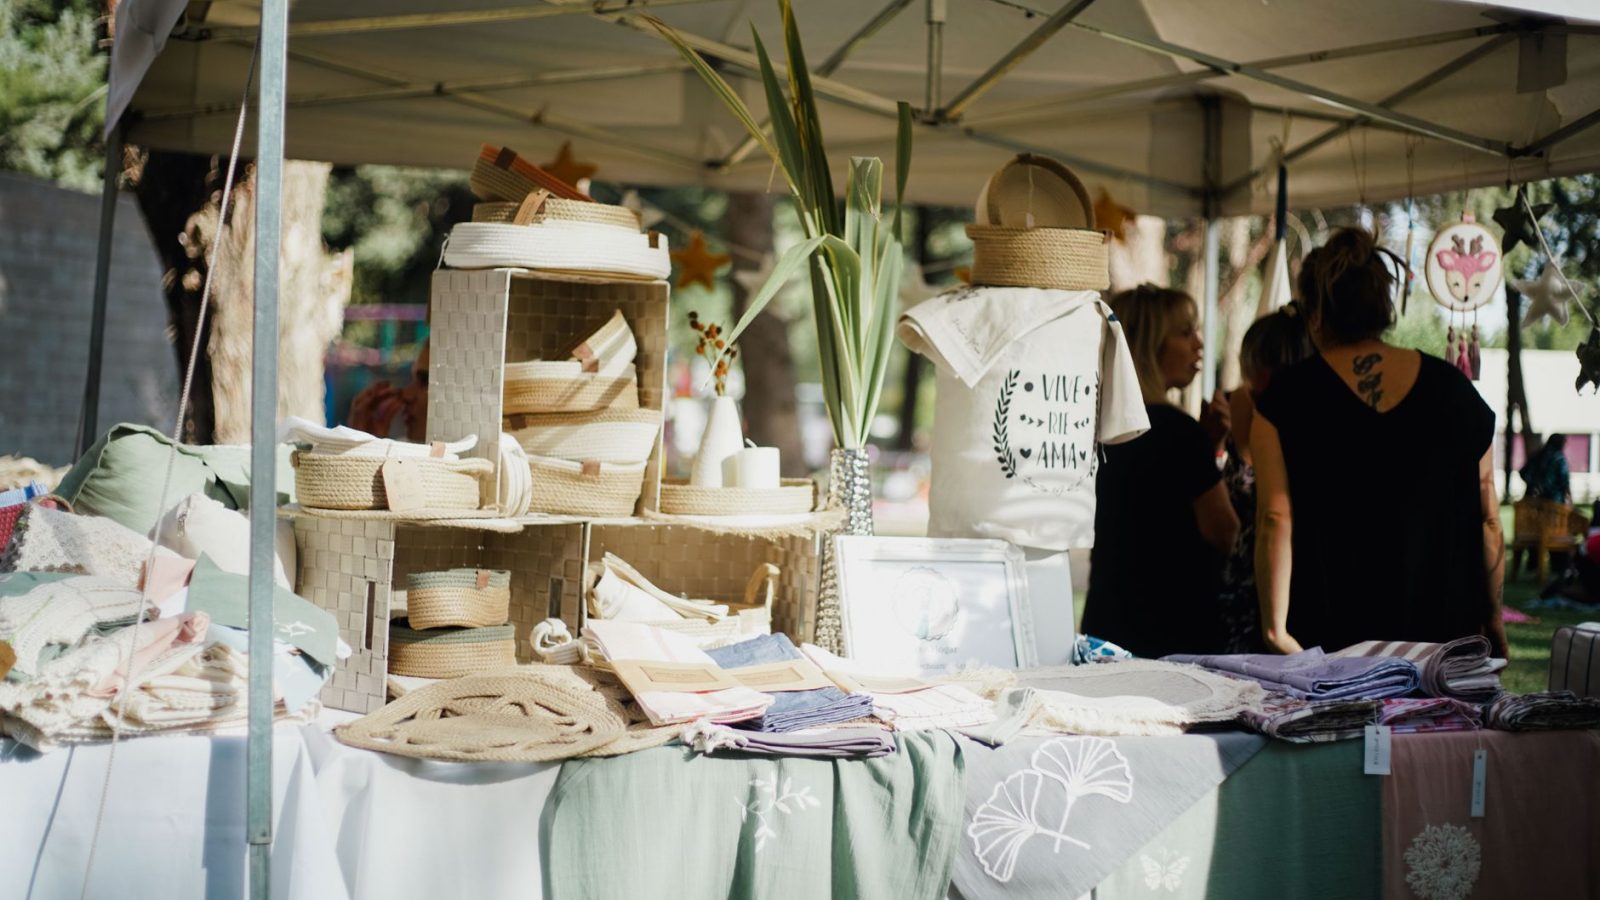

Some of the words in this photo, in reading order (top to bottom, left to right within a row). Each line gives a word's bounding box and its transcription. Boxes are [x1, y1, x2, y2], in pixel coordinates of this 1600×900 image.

[1042, 374, 1082, 403] VIVE
[1048, 411, 1068, 435] RIE
[1036, 441, 1077, 469] AMA
